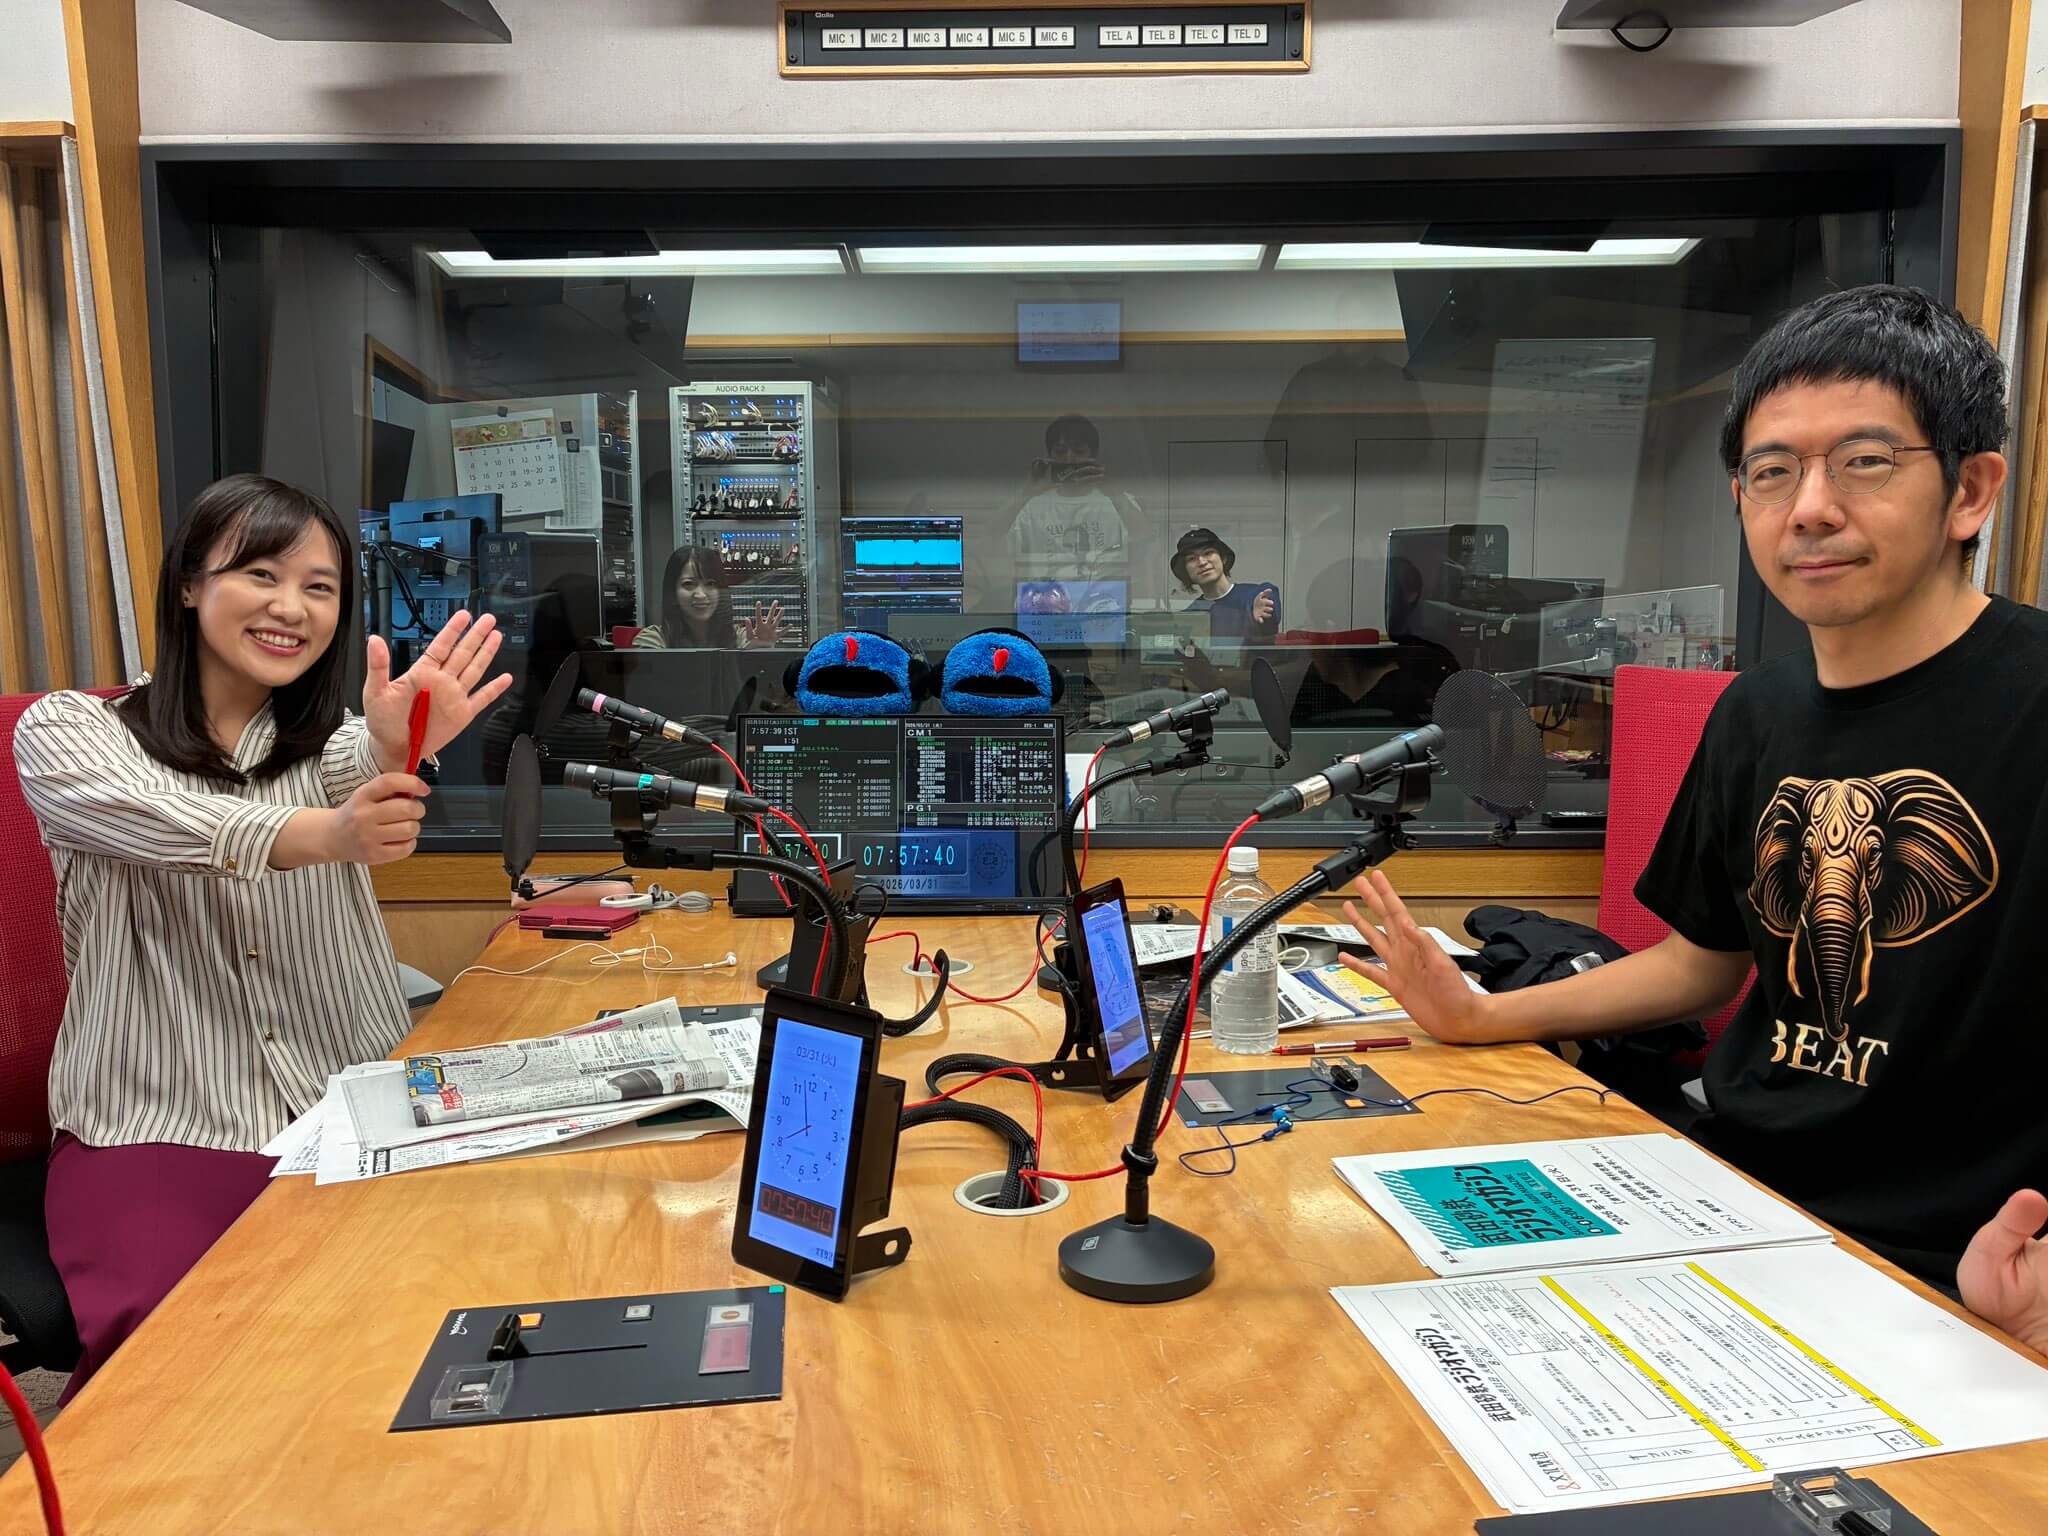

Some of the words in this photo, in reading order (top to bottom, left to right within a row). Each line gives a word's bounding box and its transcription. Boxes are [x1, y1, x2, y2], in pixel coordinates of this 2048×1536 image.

[828, 32, 848, 45] MIC
[850, 32, 855, 45] 1
[871, 31, 890, 44] MIC
[892, 31, 898, 44] 2
[913, 32, 932, 45] MIC
[934, 32, 940, 45] 3
[956, 31, 975, 44] MIC
[976, 31, 983, 44] 4
[998, 31, 1017, 43] MIC
[1019, 31, 1026, 43] 5
[1041, 31, 1060, 43] MIC
[1061, 31, 1068, 43] 6
[1106, 30, 1123, 42] TEL
[1125, 30, 1133, 42] A
[1149, 30, 1165, 41] TEL
[1168, 30, 1175, 41] B
[1191, 29, 1208, 40] TEL
[1210, 29, 1219, 40] C
[1234, 28, 1251, 40] TEL
[1253, 28, 1261, 40] D
[499, 424, 507, 436] 3
[863, 845, 955, 867] 07:57:40
[880, 879, 939, 891] 2026/03/31
[796, 1046, 819, 1061] 03/31
[1770, 1019, 1889, 1087] BEAT
[794, 1083, 801, 1094] 11
[808, 1082, 817, 1093] 12
[782, 1095, 790, 1106] 10
[824, 1091, 827, 1102] 1
[776, 1115, 782, 1126] 9
[832, 1110, 837, 1120] 2
[777, 1136, 782, 1147] 8
[832, 1132, 838, 1142] 3
[786, 1154, 791, 1165] 7
[826, 1152, 831, 1161] 4
[799, 1165, 804, 1175] 6
[812, 1163, 818, 1174] 5
[1454, 1166, 1563, 1238] ラジオマガジン
[1442, 1197, 1513, 1244] 武田砂鉄
[1477, 1348, 1500, 1365] 8:00
